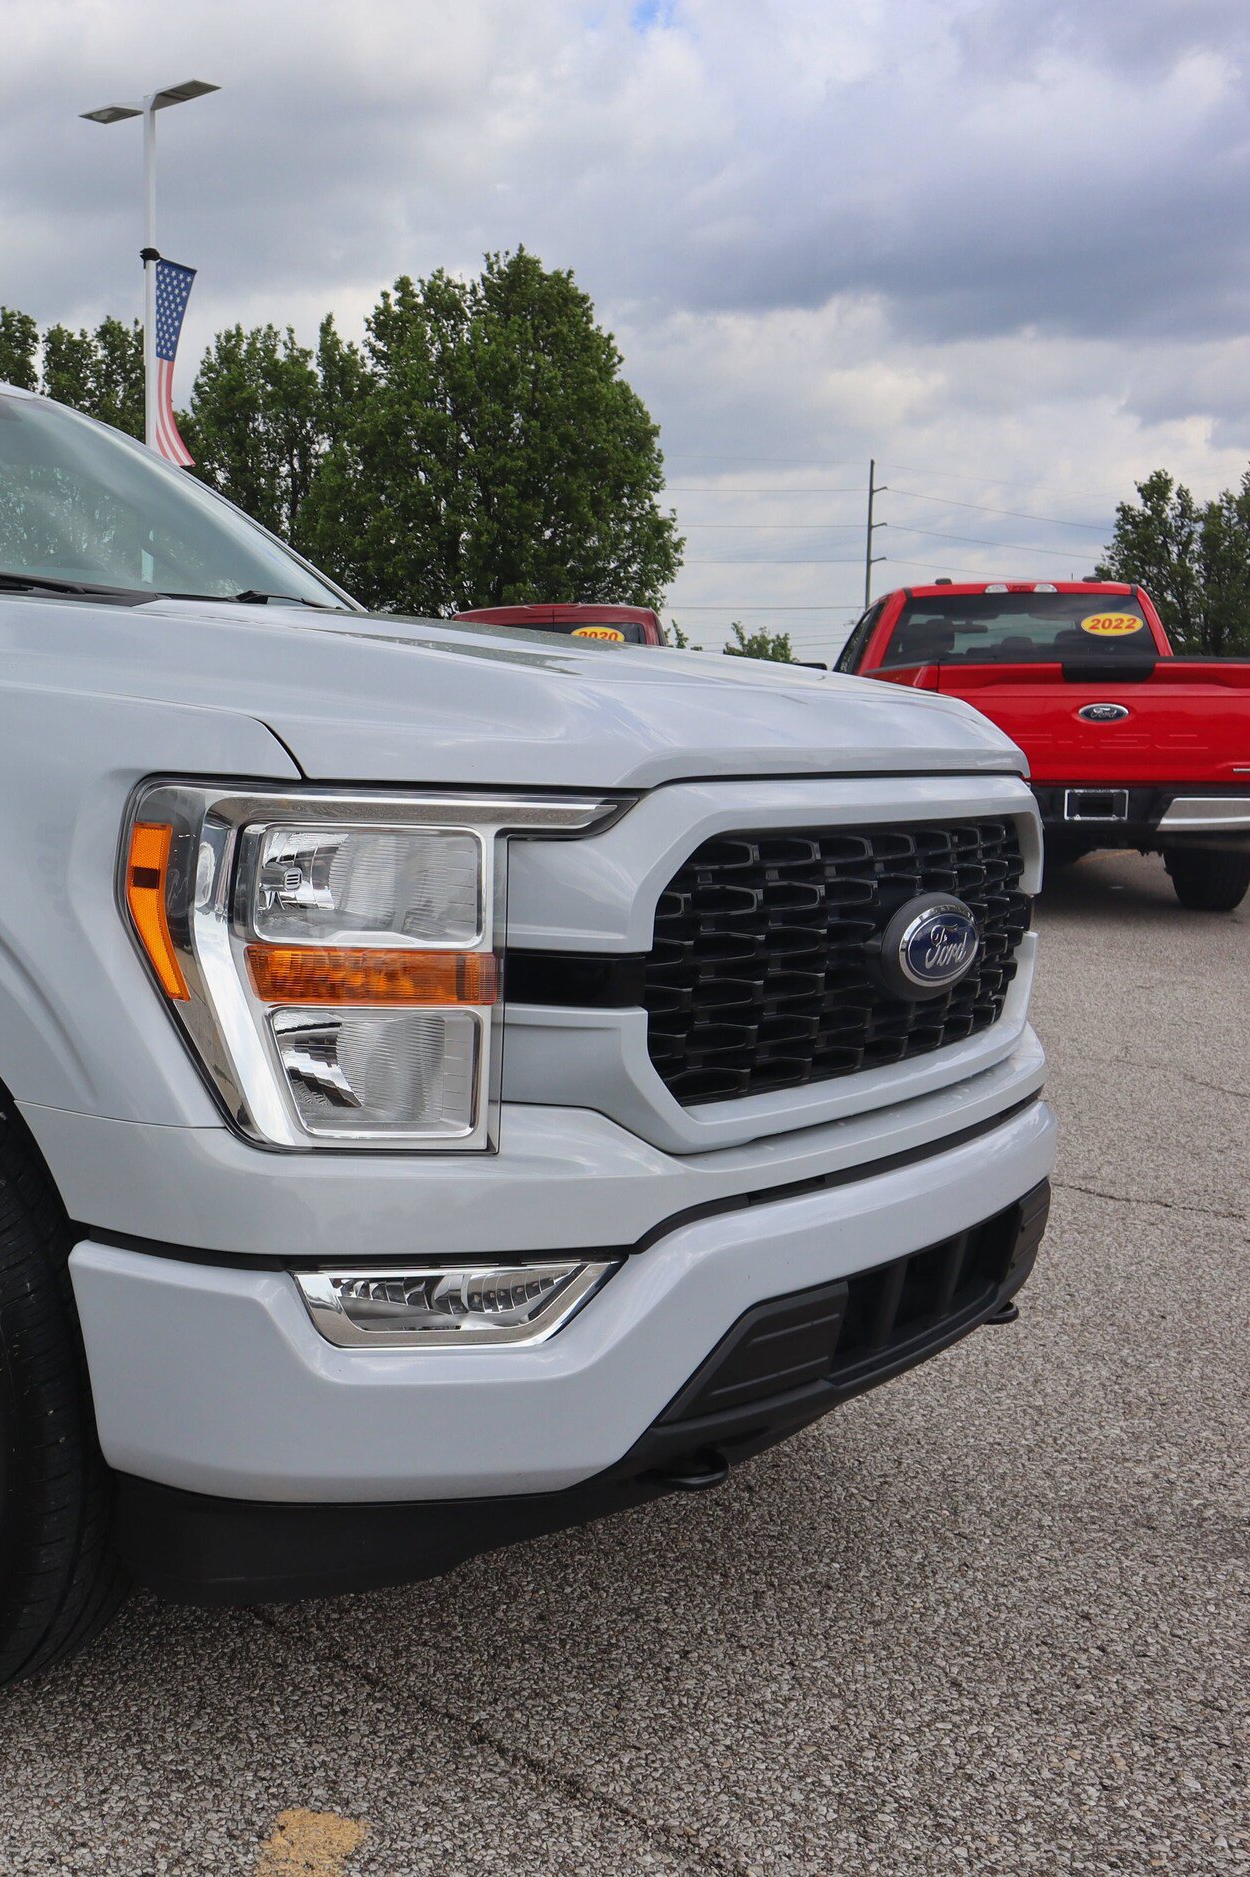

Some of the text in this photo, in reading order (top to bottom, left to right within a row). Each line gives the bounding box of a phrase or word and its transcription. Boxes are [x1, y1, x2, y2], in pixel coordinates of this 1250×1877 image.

[1088, 617, 1138, 630] 2022
[1090, 707, 1118, 719] Ford
[924, 923, 968, 969] Ford
